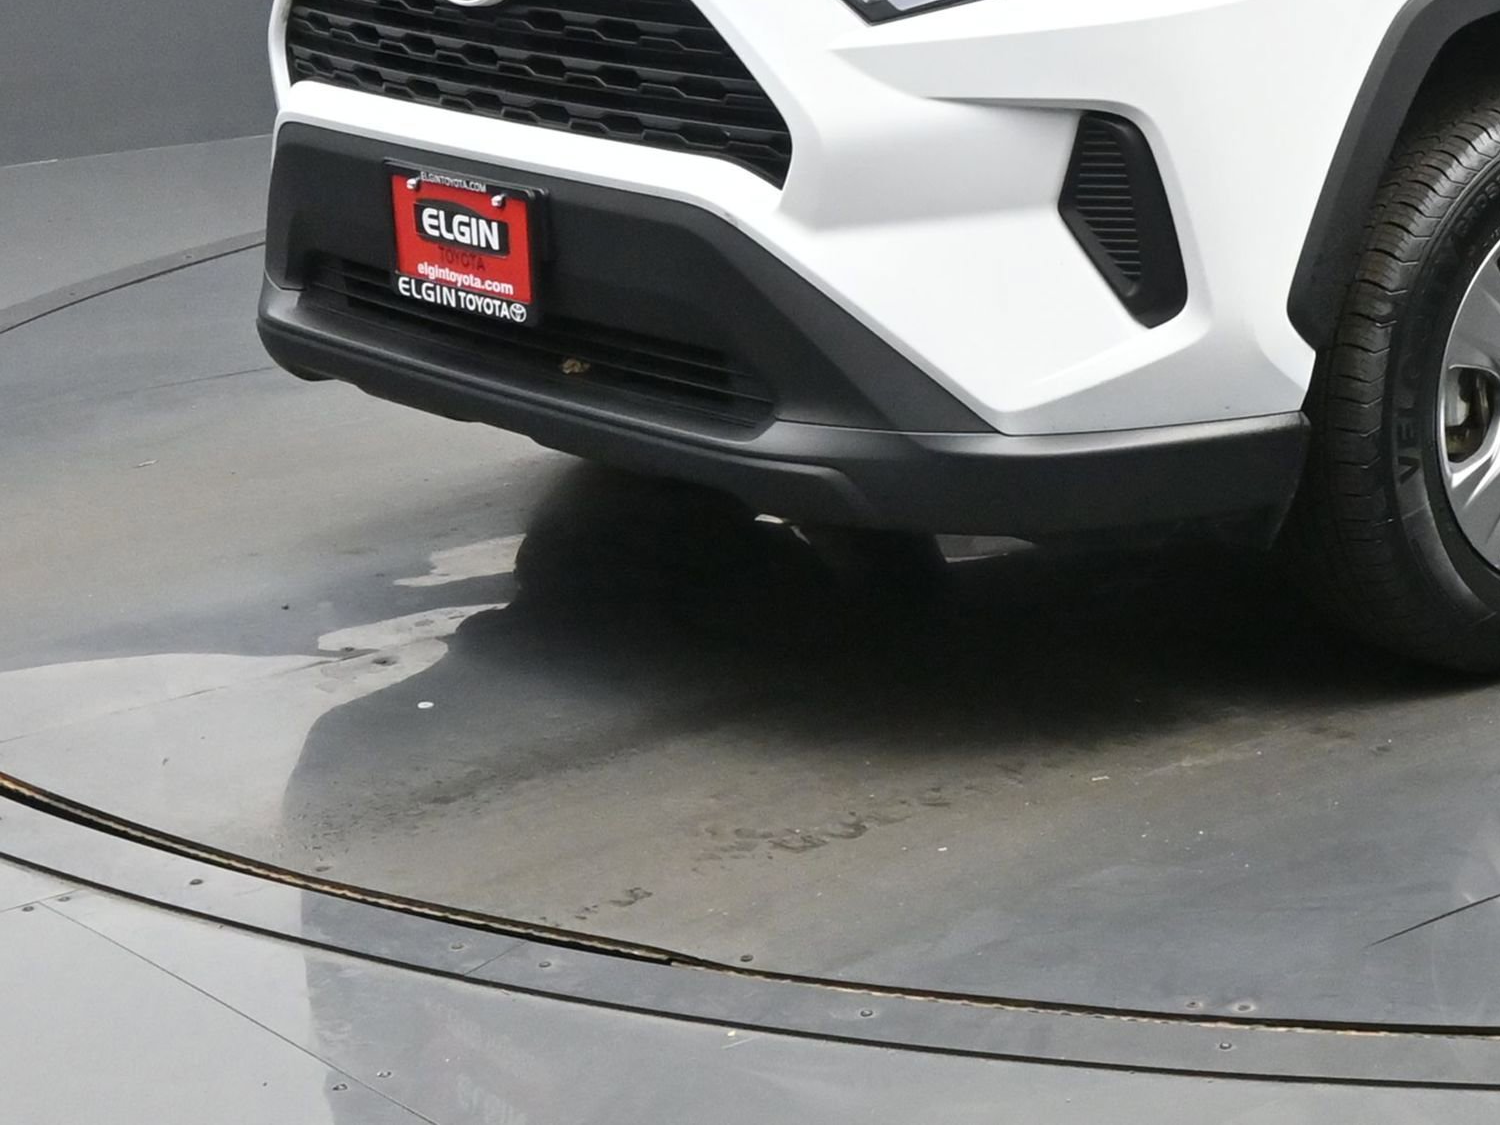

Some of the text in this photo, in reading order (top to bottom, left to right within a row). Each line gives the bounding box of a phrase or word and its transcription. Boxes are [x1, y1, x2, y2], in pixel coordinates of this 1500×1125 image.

[420, 171, 487, 193] ELGINTOYOTA.COM
[422, 207, 500, 250] ELGIN
[439, 245, 486, 272] TOYOTA
[417, 261, 514, 296] elgintoyota.com
[398, 277, 511, 320] ELGIN TOYOTA
